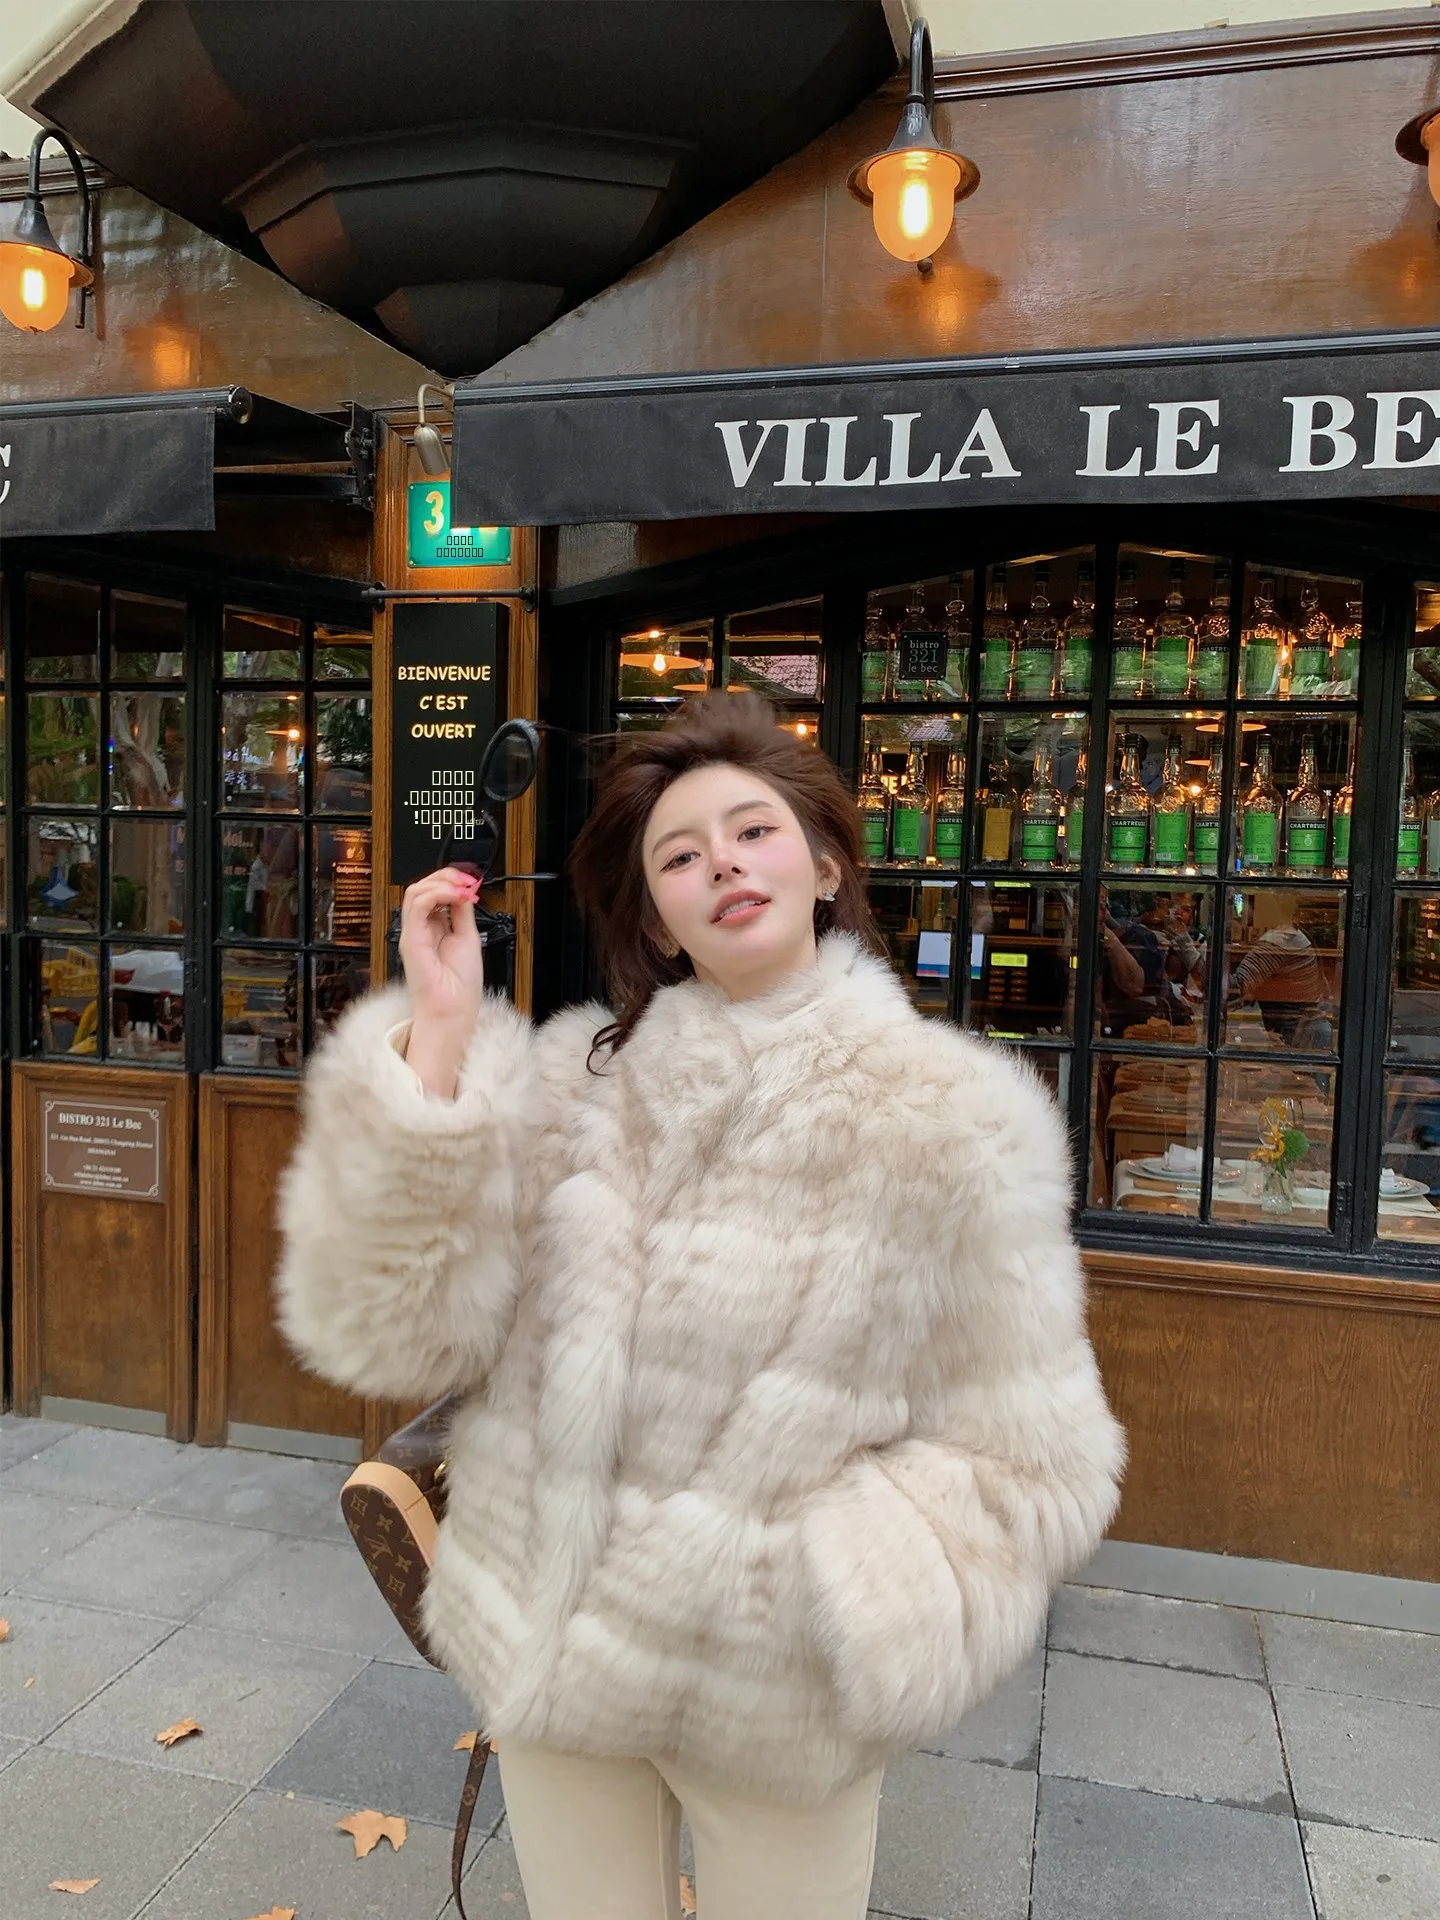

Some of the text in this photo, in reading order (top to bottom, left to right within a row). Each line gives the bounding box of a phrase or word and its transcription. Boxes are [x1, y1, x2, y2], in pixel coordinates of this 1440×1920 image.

[714, 389, 1440, 488] VILLA LE BE
[909, 640, 940, 649] bistro
[908, 648, 938, 664] 321
[397, 665, 492, 681] BIENVENUE
[908, 662, 938, 673] le bec
[419, 694, 469, 711] C'EST
[411, 722, 477, 739] OUVERT
[59, 1112, 94, 1126] BISTRO
